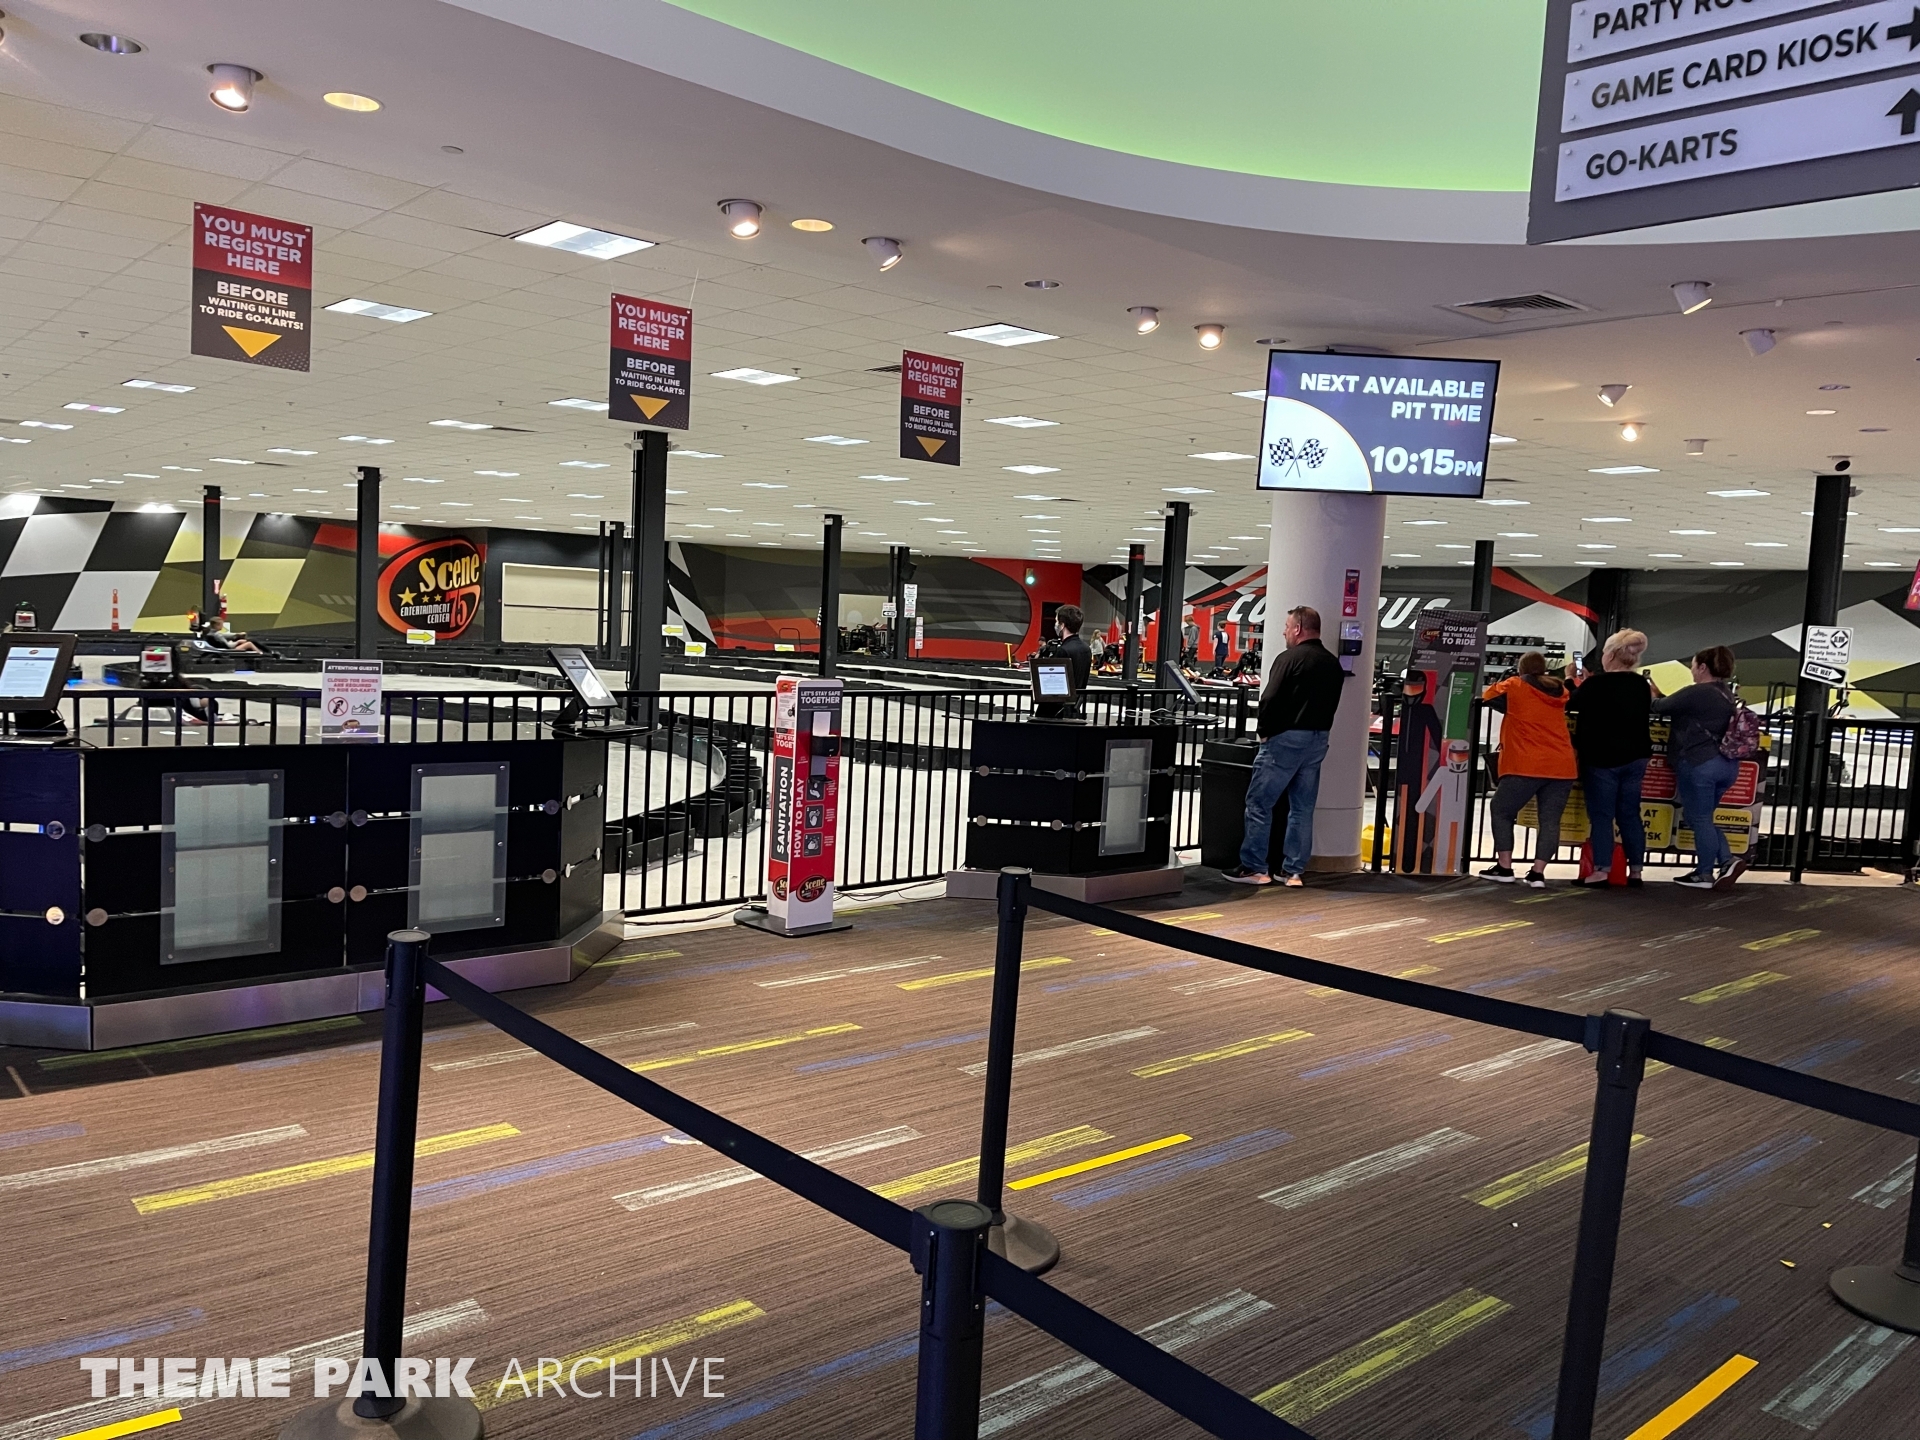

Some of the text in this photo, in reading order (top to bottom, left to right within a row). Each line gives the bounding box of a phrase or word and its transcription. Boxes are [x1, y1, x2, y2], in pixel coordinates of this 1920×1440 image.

[1592, 0, 1683, 39] PARTY
[1592, 22, 1880, 109] GAME CARD KIOSK
[1585, 128, 1738, 180] GO-KARTS
[201, 213, 306, 247] YOU MUST
[205, 231, 302, 263] REGISTER
[227, 253, 280, 275] HERE
[217, 281, 289, 306] BEFORE
[199, 304, 304, 330] TO RIDE GO-KARTS!
[208, 296, 296, 319] WAITING IN LINE
[616, 301, 688, 327] YOU MUST
[618, 317, 685, 340] REGISTER
[633, 334, 670, 351] HERE
[626, 357, 675, 376] BEFORE
[906, 357, 960, 377] YOU MUST
[614, 377, 685, 395] TO RIDE GO-KARTS!
[620, 370, 680, 387] WAITING IN LINE
[908, 370, 957, 389] REGISTER
[1300, 372, 1485, 399] NEXT AVAILABLE
[918, 384, 946, 398] HERE
[908, 416, 933, 425] WAITING
[941, 421, 954, 429] LINE
[913, 404, 950, 419] BEFORE
[1391, 401, 1482, 423] PIT TIME
[1369, 445, 1483, 477] 10:15PM
[418, 553, 480, 593] Scene
[400, 603, 451, 617] ENTERTAINMENT
[445, 585, 475, 628] 75
[427, 613, 450, 624] CENTER
[1442, 637, 1476, 646] TO RIDE
[1808, 665, 1820, 673] ONE
[800, 696, 840, 704] TOGETHER
[776, 766, 789, 855] SANITATION
[793, 778, 805, 858] HOW TO PLAY
[1643, 809, 1658, 818] AT
[1715, 814, 1750, 823] CONTROL
